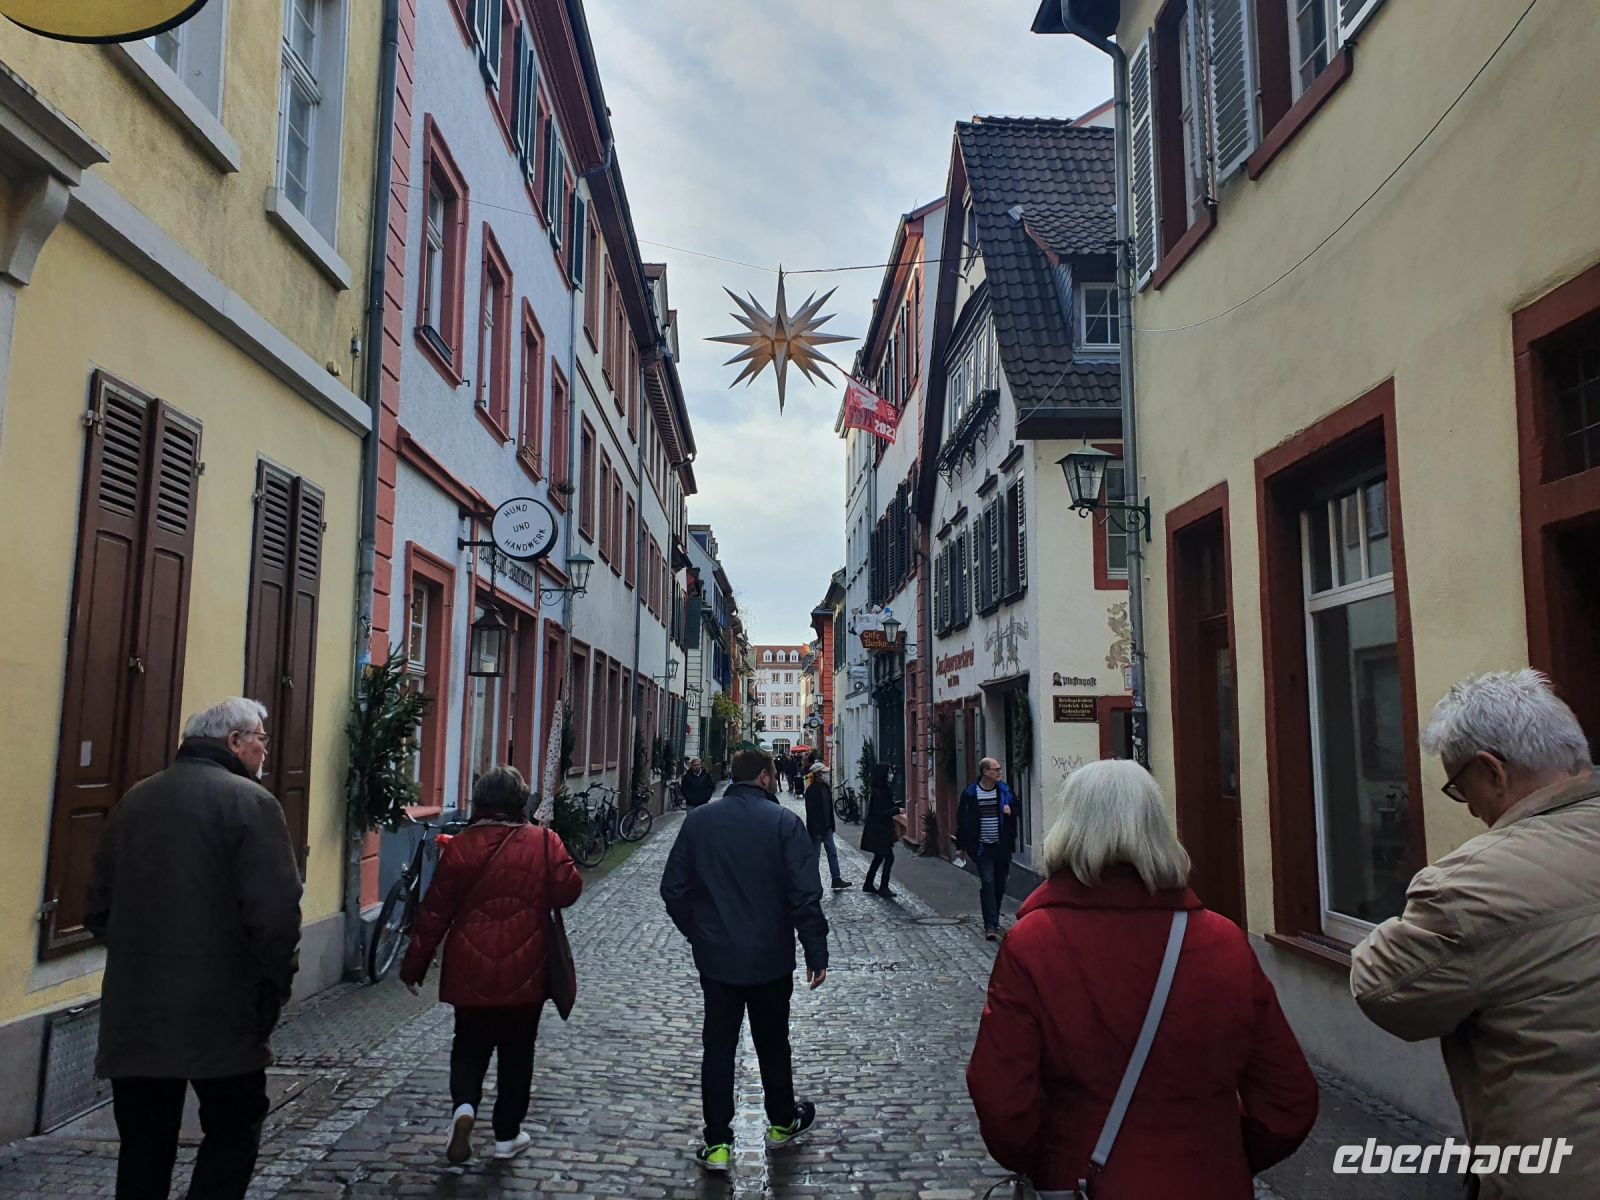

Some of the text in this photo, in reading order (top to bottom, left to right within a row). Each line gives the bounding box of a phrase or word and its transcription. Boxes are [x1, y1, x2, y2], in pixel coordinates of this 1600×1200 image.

[503, 504, 528, 518] HUND
[512, 521, 530, 533] UND
[504, 528, 547, 552] HANDWERK
